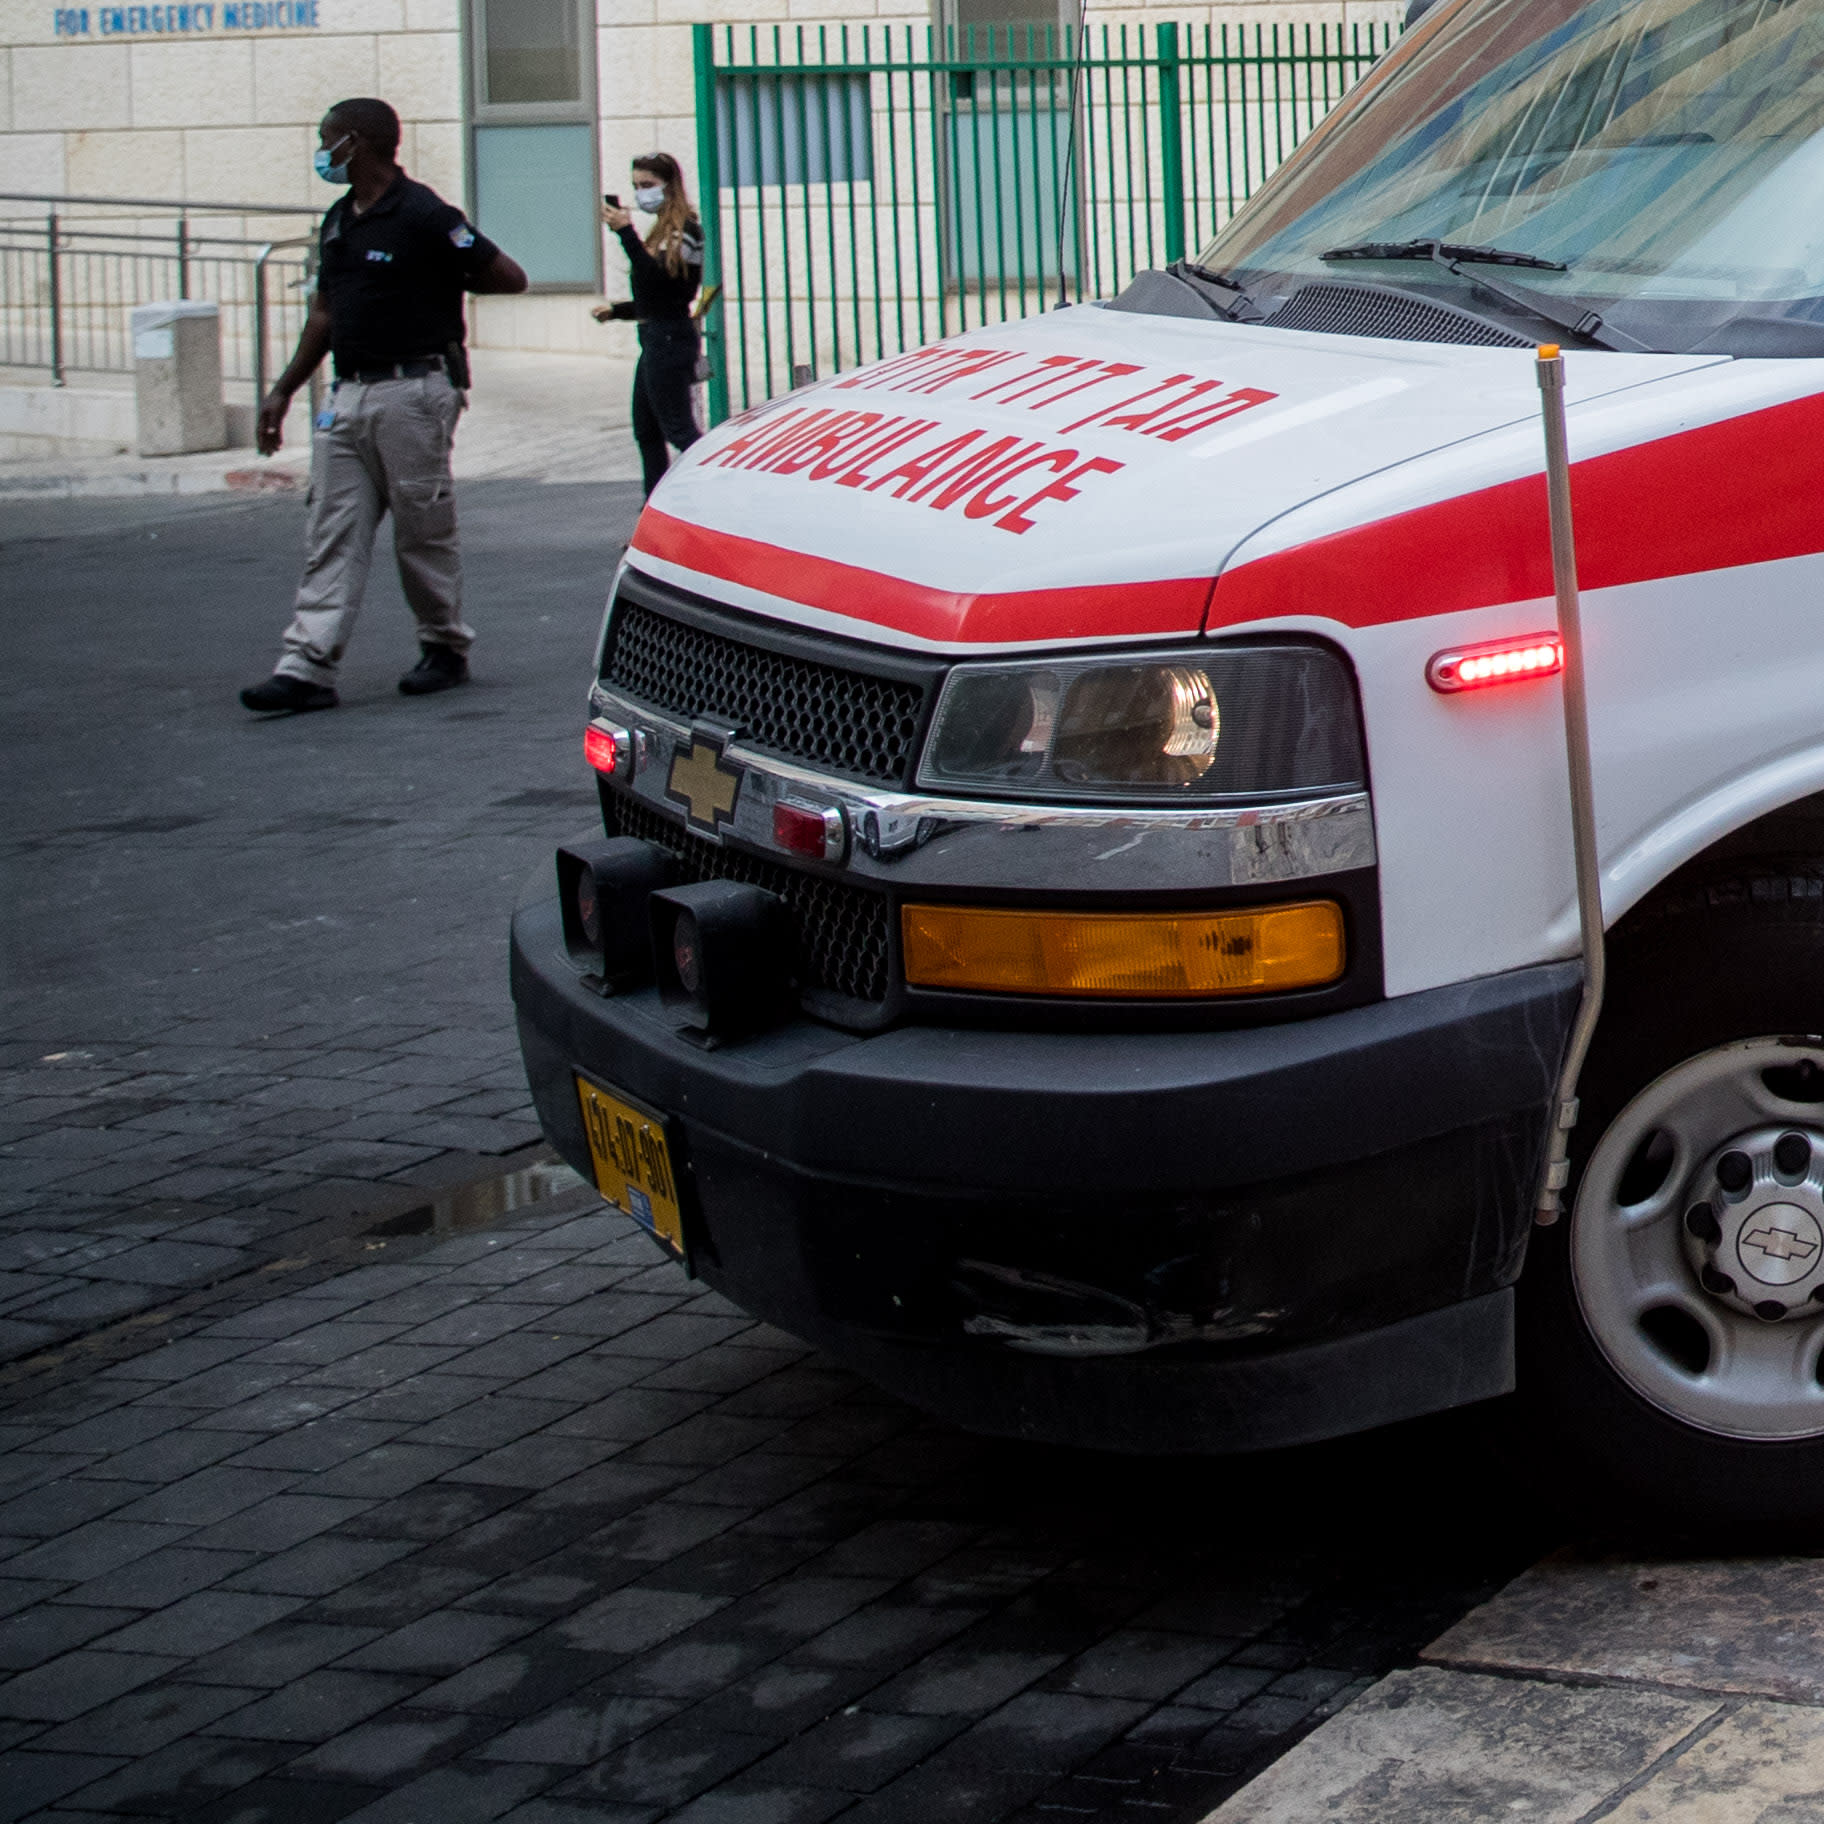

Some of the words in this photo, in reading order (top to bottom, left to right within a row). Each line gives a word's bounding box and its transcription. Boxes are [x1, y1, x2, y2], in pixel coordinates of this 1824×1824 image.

[54, 8, 90, 36] FOR
[100, 3, 215, 36] EMERGENCY
[223, 0, 321, 30] MEDICINE
[969, 355, 1148, 410] דוד
[1056, 373, 1280, 442] מגן
[697, 406, 1126, 536] AMBULANCE
